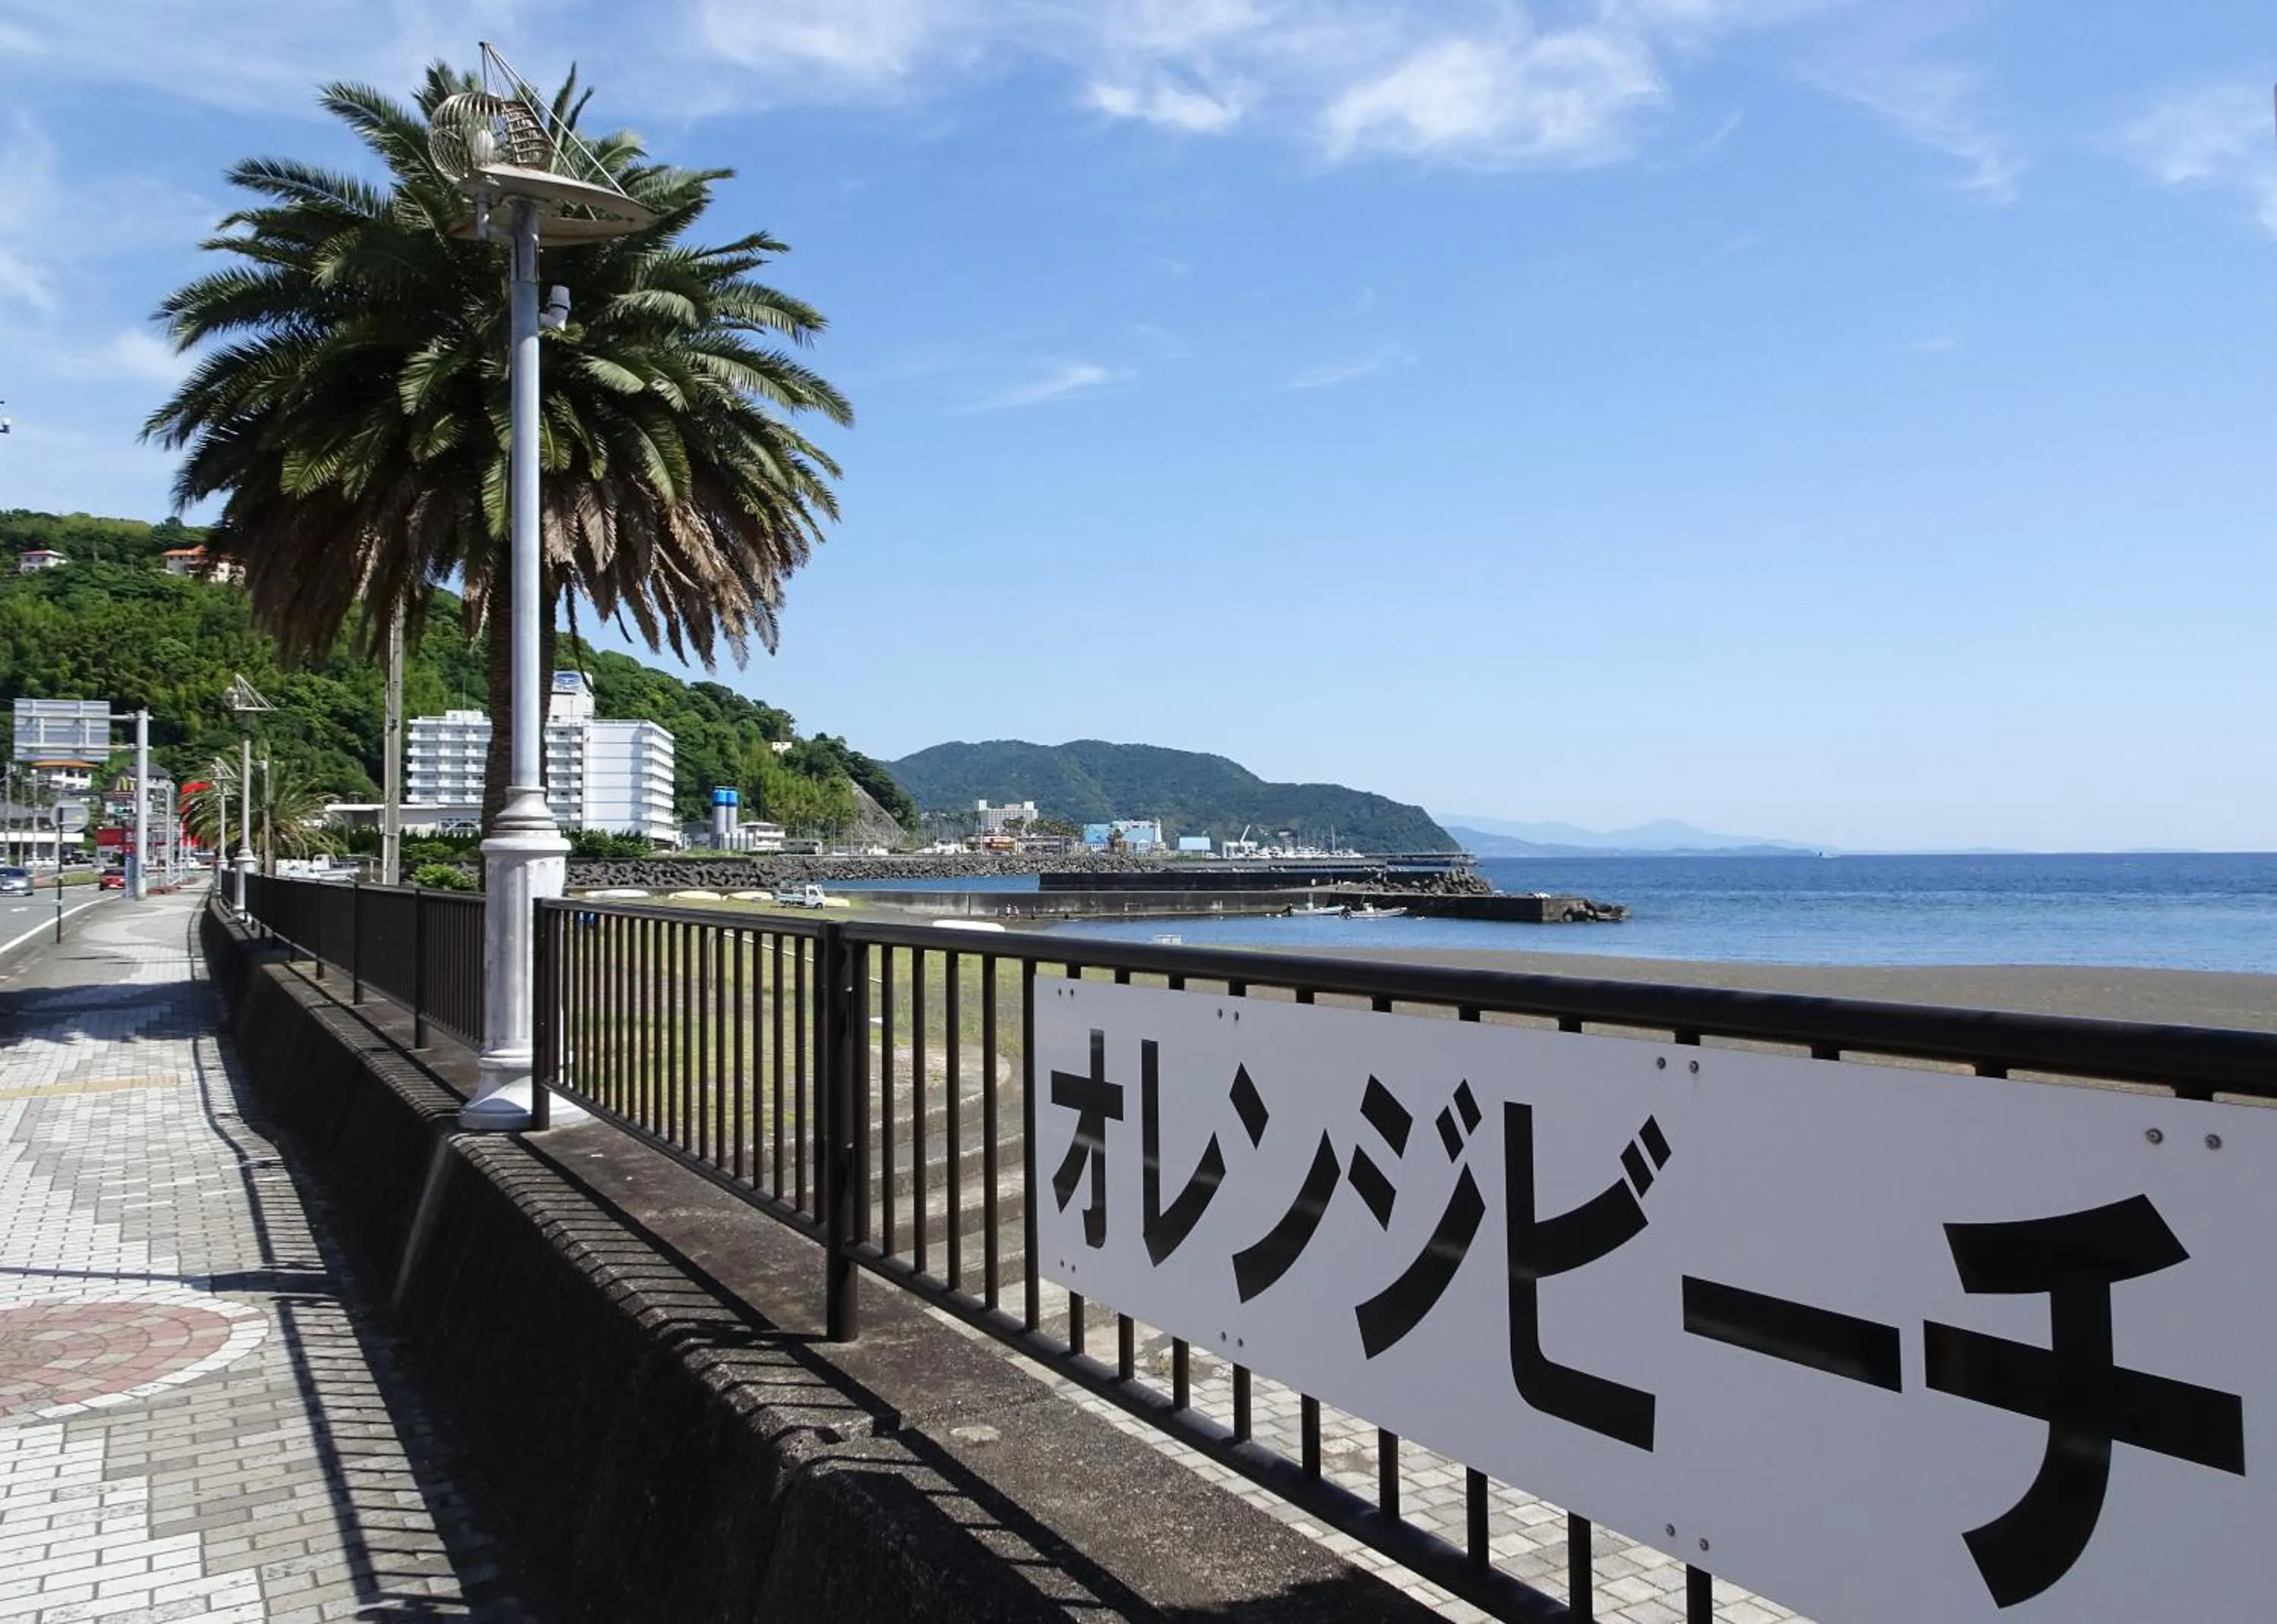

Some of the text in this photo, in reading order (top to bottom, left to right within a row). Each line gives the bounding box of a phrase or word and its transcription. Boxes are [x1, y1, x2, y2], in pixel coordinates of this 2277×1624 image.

[1051, 1029, 2246, 1609] オレンジビーチ
